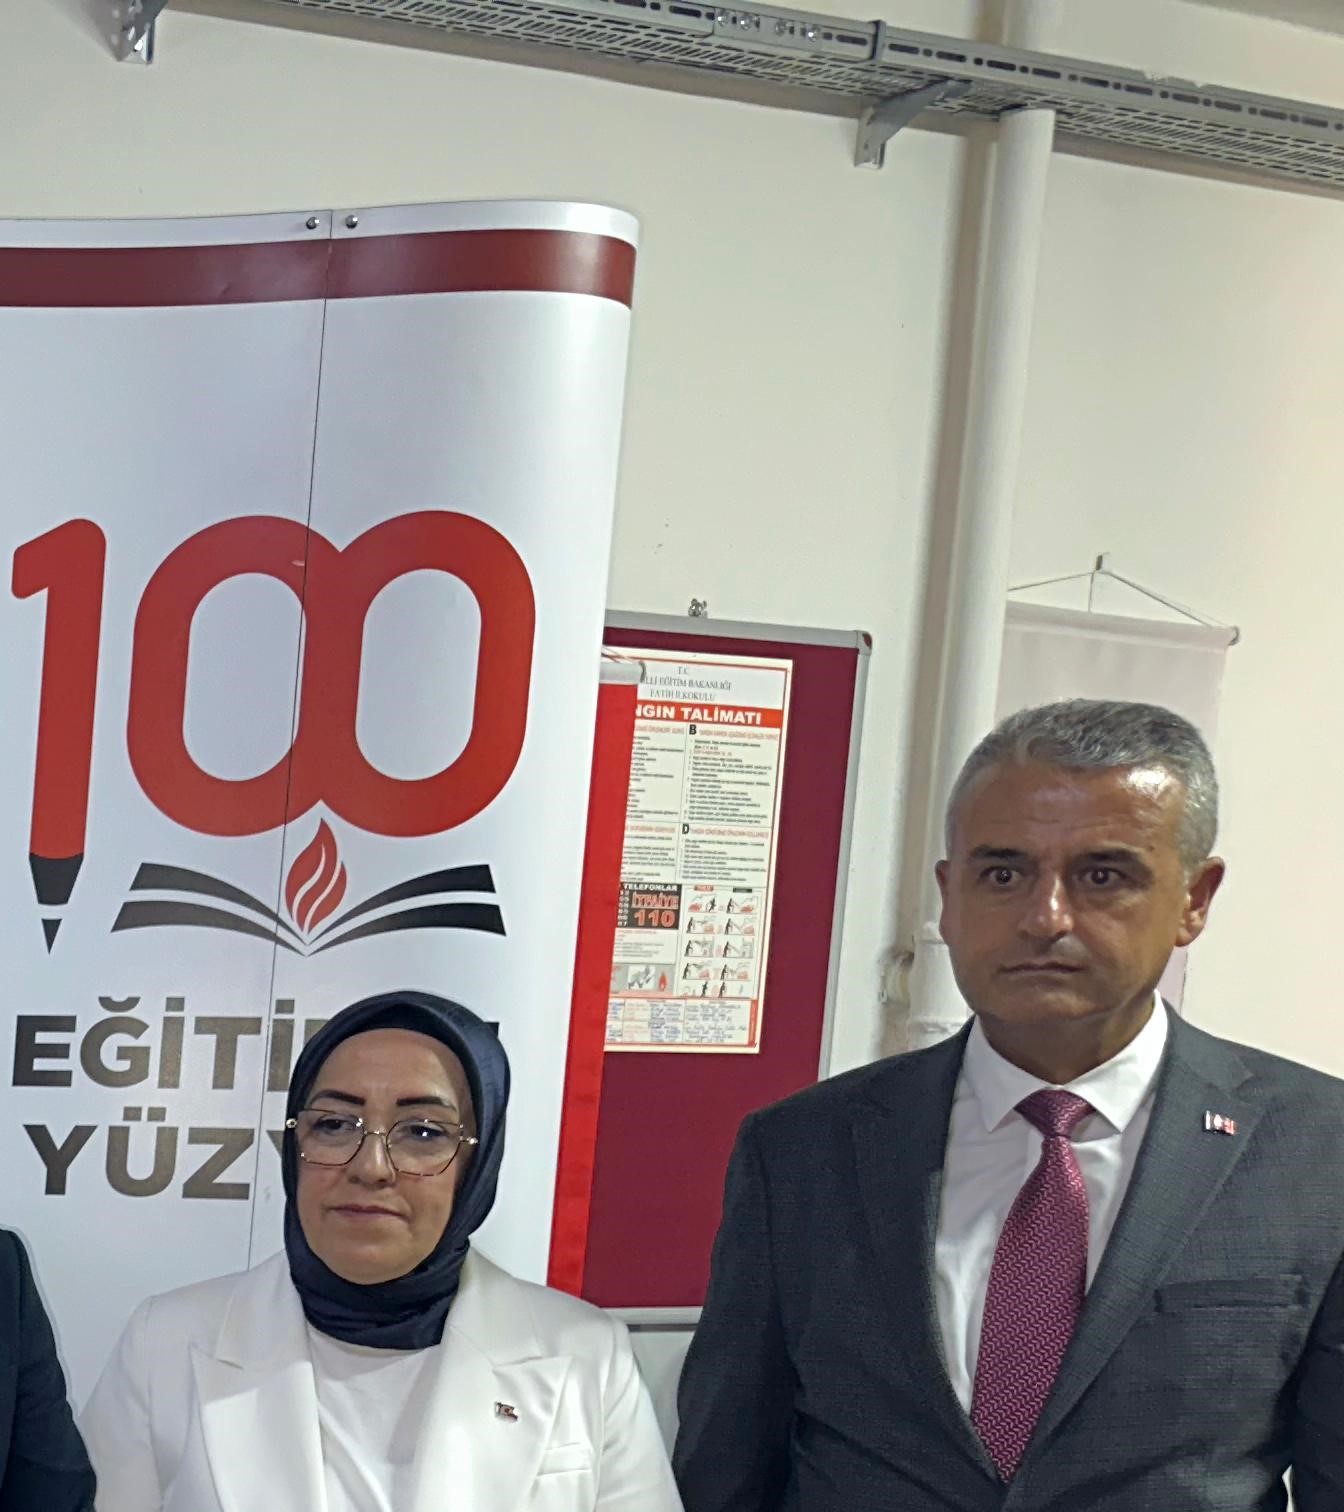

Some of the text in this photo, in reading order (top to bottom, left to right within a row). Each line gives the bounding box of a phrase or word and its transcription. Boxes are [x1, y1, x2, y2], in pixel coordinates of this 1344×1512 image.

[12, 510, 536, 953] 100
[680, 706, 762, 725] TALİMATI
[633, 908, 675, 928] 110
[12, 996, 324, 1092] EĞİTİ
[23, 1106, 286, 1200] YÜZ
